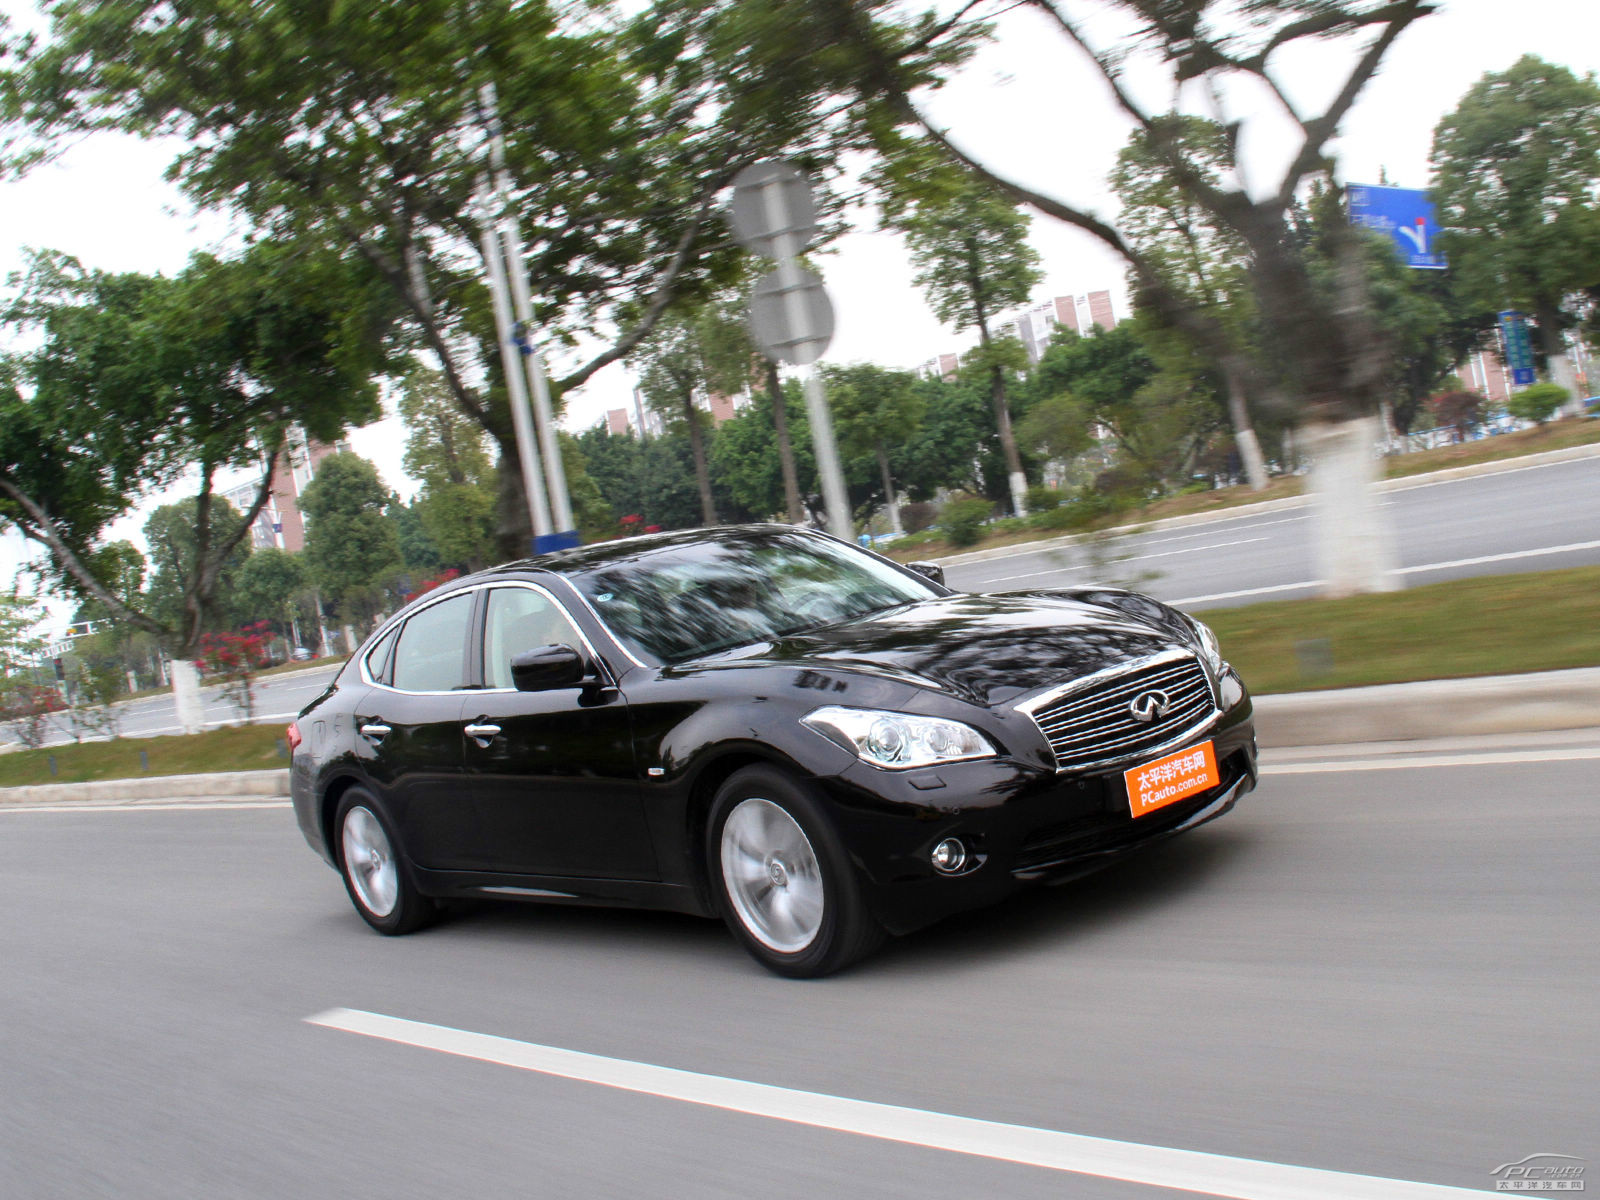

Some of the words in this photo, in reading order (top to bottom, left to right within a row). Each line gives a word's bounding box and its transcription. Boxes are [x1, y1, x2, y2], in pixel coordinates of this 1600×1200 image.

[1137, 750, 1206, 792] 太平洋汽车网
[1140, 773, 1208, 807] PCauto.com.cn
